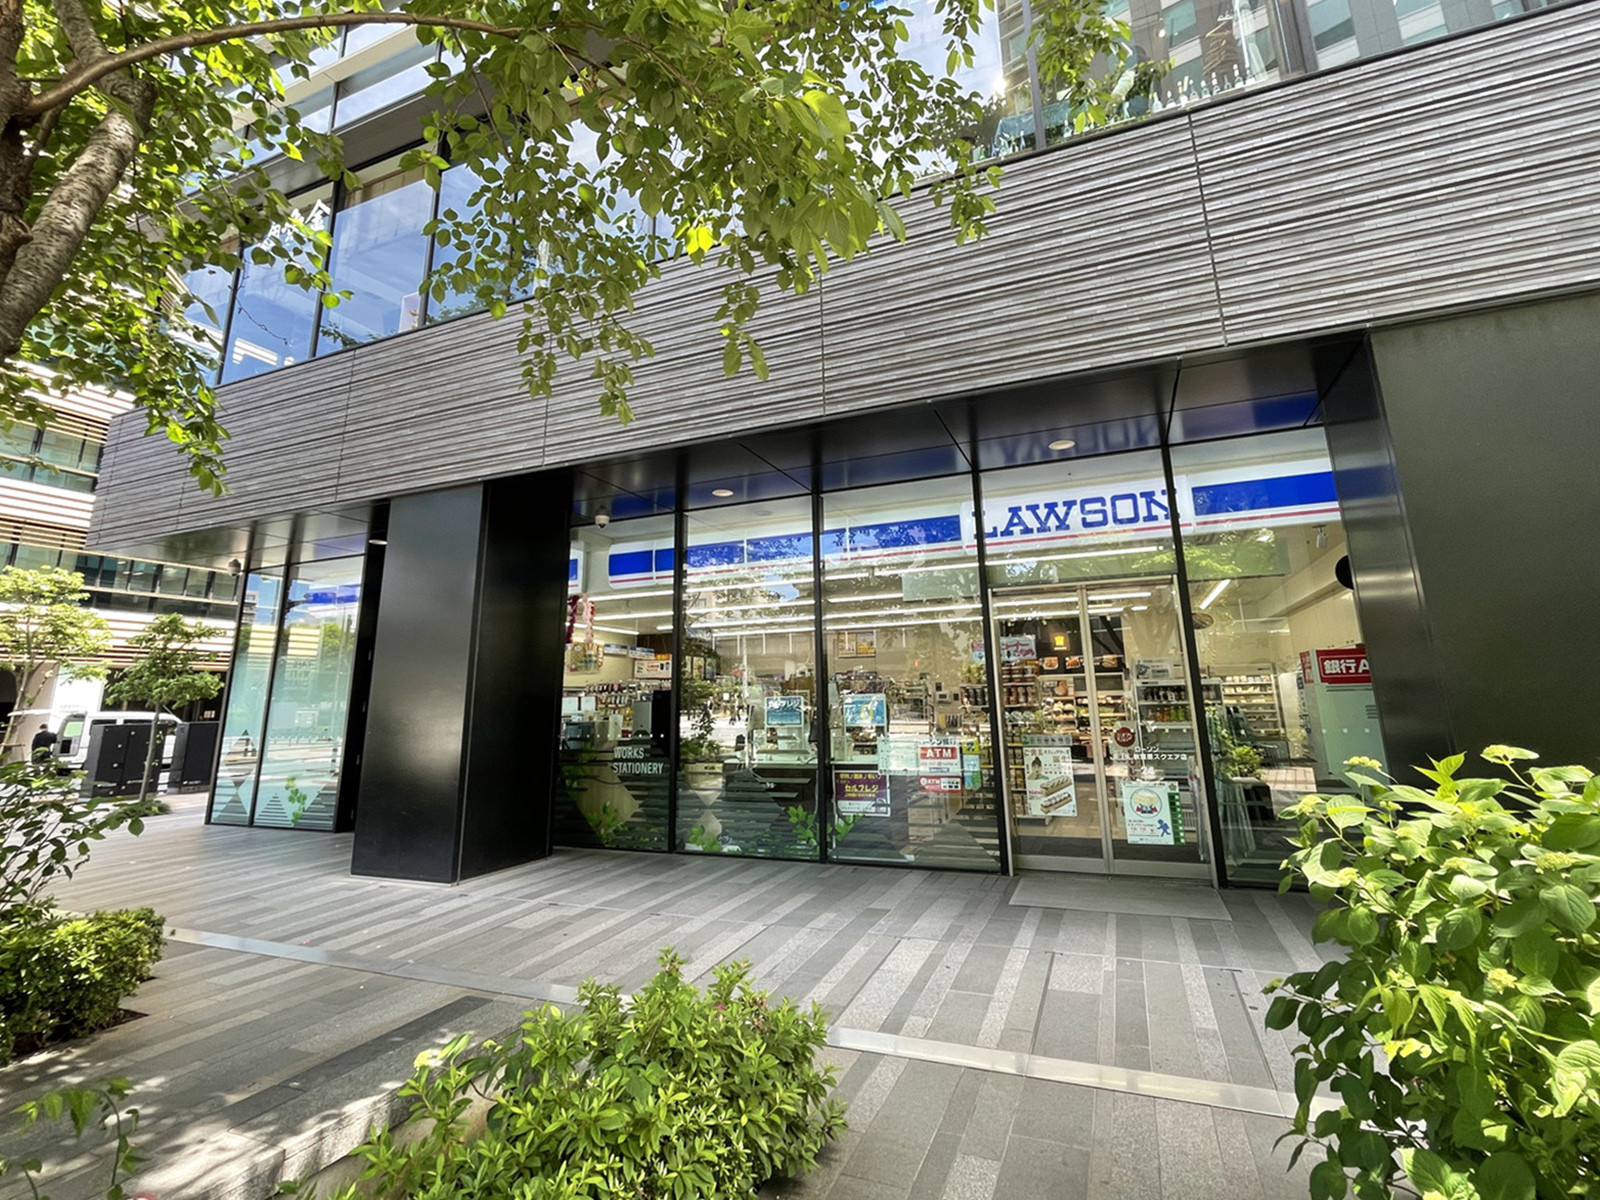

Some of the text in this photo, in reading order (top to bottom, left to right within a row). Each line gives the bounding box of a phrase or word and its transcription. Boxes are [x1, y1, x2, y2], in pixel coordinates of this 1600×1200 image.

[613, 746, 645, 759] WORKS
[926, 748, 952, 758] ATM
[612, 762, 664, 775] STATIONERY
